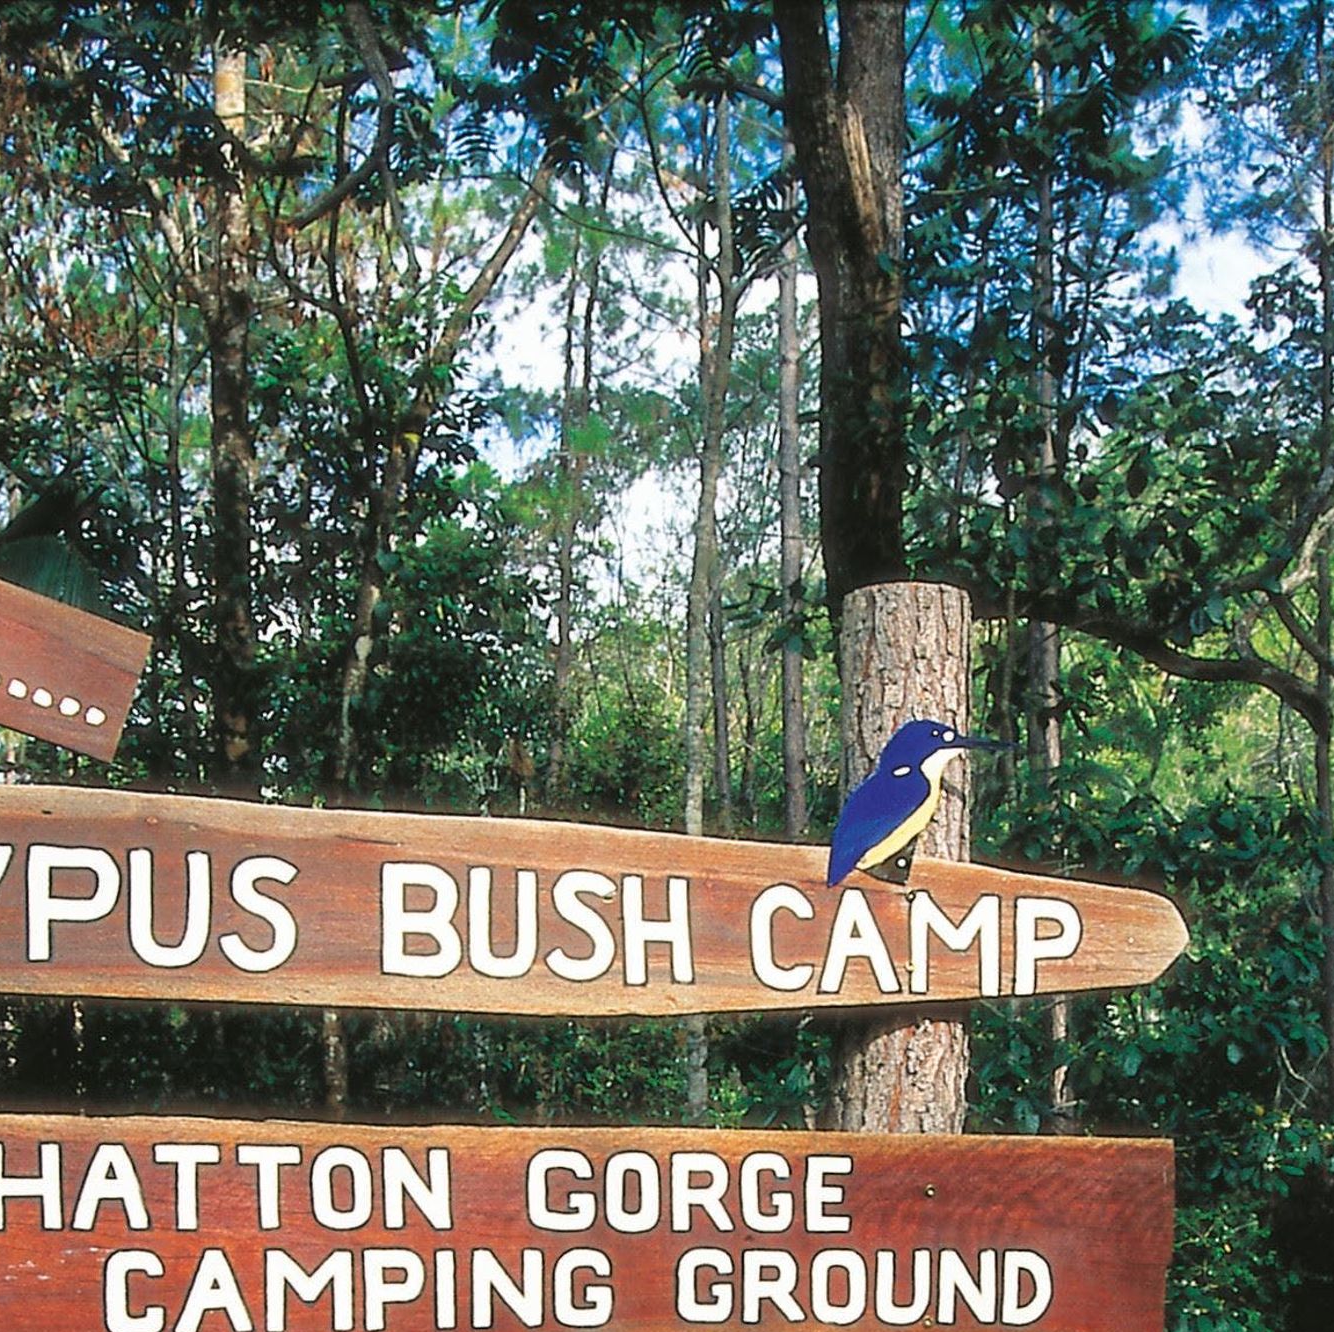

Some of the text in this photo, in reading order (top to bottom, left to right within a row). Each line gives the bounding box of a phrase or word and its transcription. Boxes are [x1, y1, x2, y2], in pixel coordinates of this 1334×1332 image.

[380, 860, 695, 987] BUSH
[749, 887, 1084, 998] CAMP
[526, 1148, 854, 1234] GORGE
[676, 1246, 1054, 1327] GROUND
